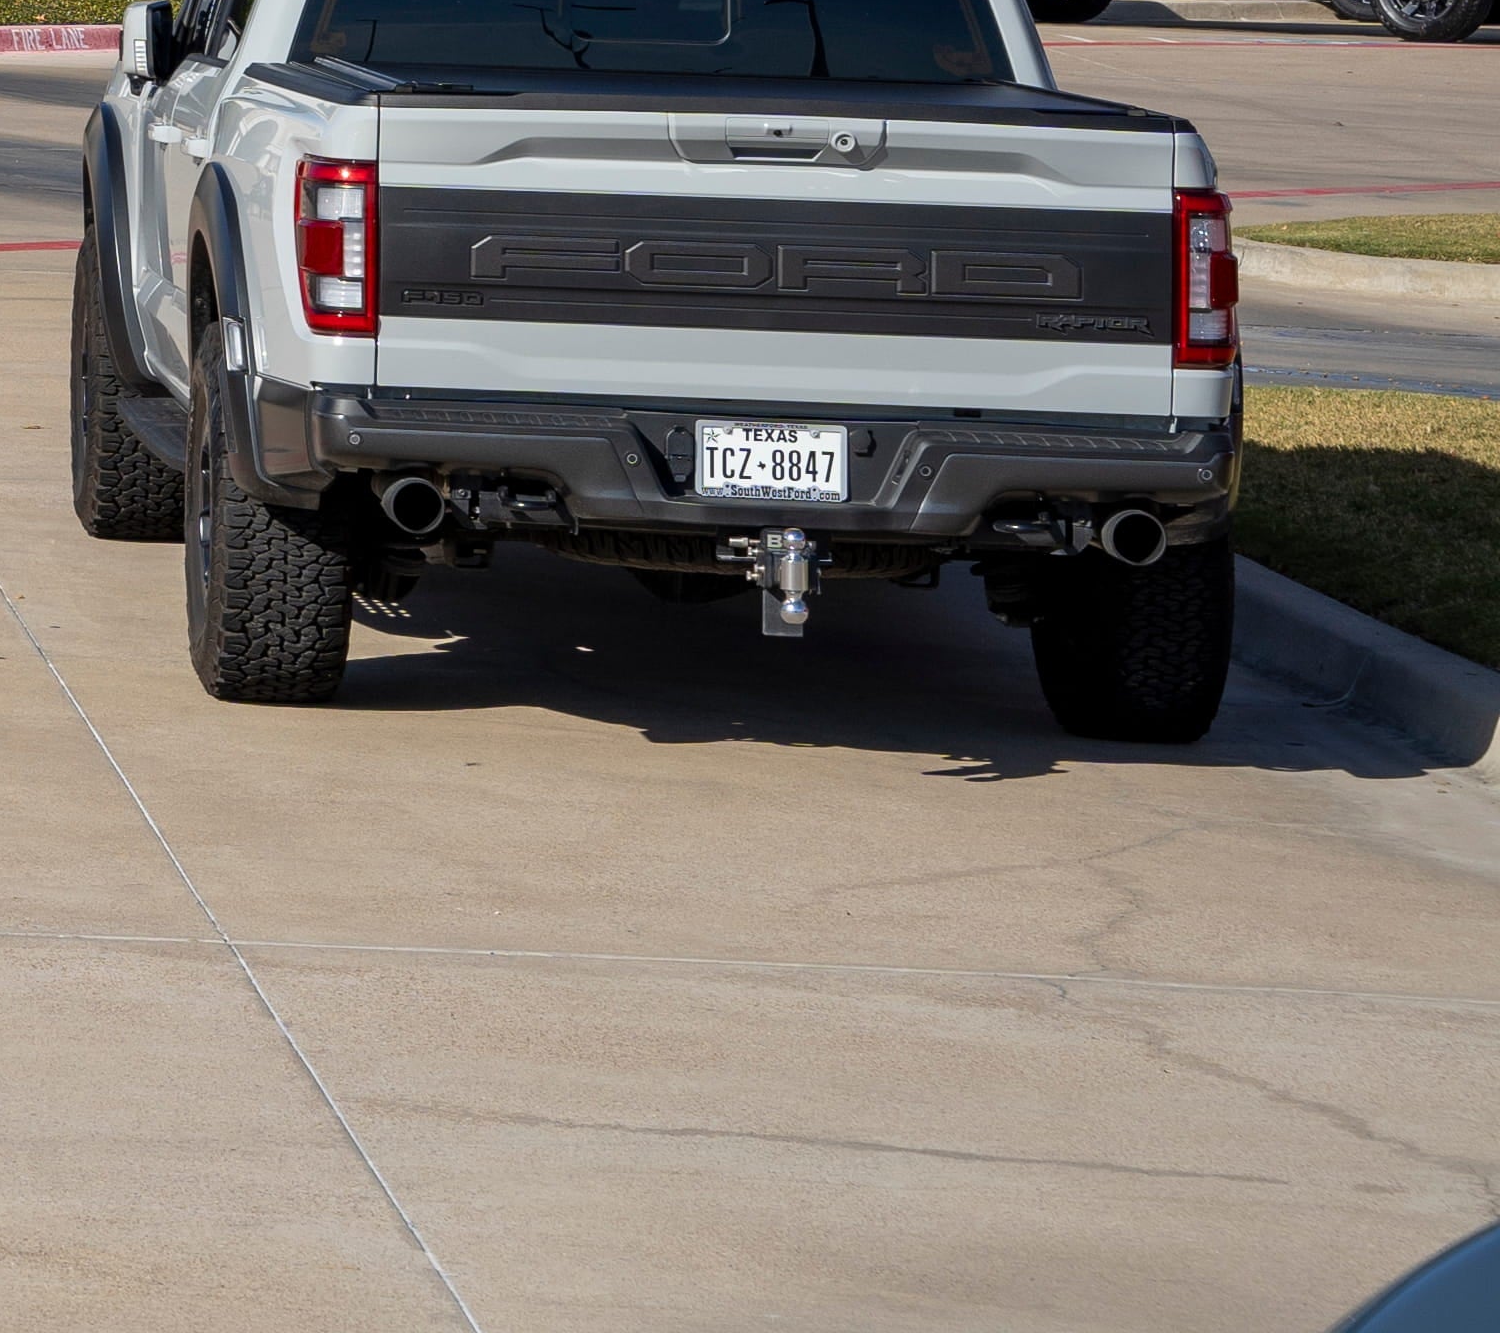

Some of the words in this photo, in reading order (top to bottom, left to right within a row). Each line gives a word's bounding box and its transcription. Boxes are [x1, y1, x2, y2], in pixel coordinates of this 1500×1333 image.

[11, 29, 45, 50] FIRE
[50, 28, 90, 49] LANE
[469, 235, 1083, 301] FORD
[1035, 312, 1155, 338] RAPTOR
[742, 428, 798, 443] TEXAS
[705, 446, 752, 479] TCZ
[771, 449, 835, 482] 8847
